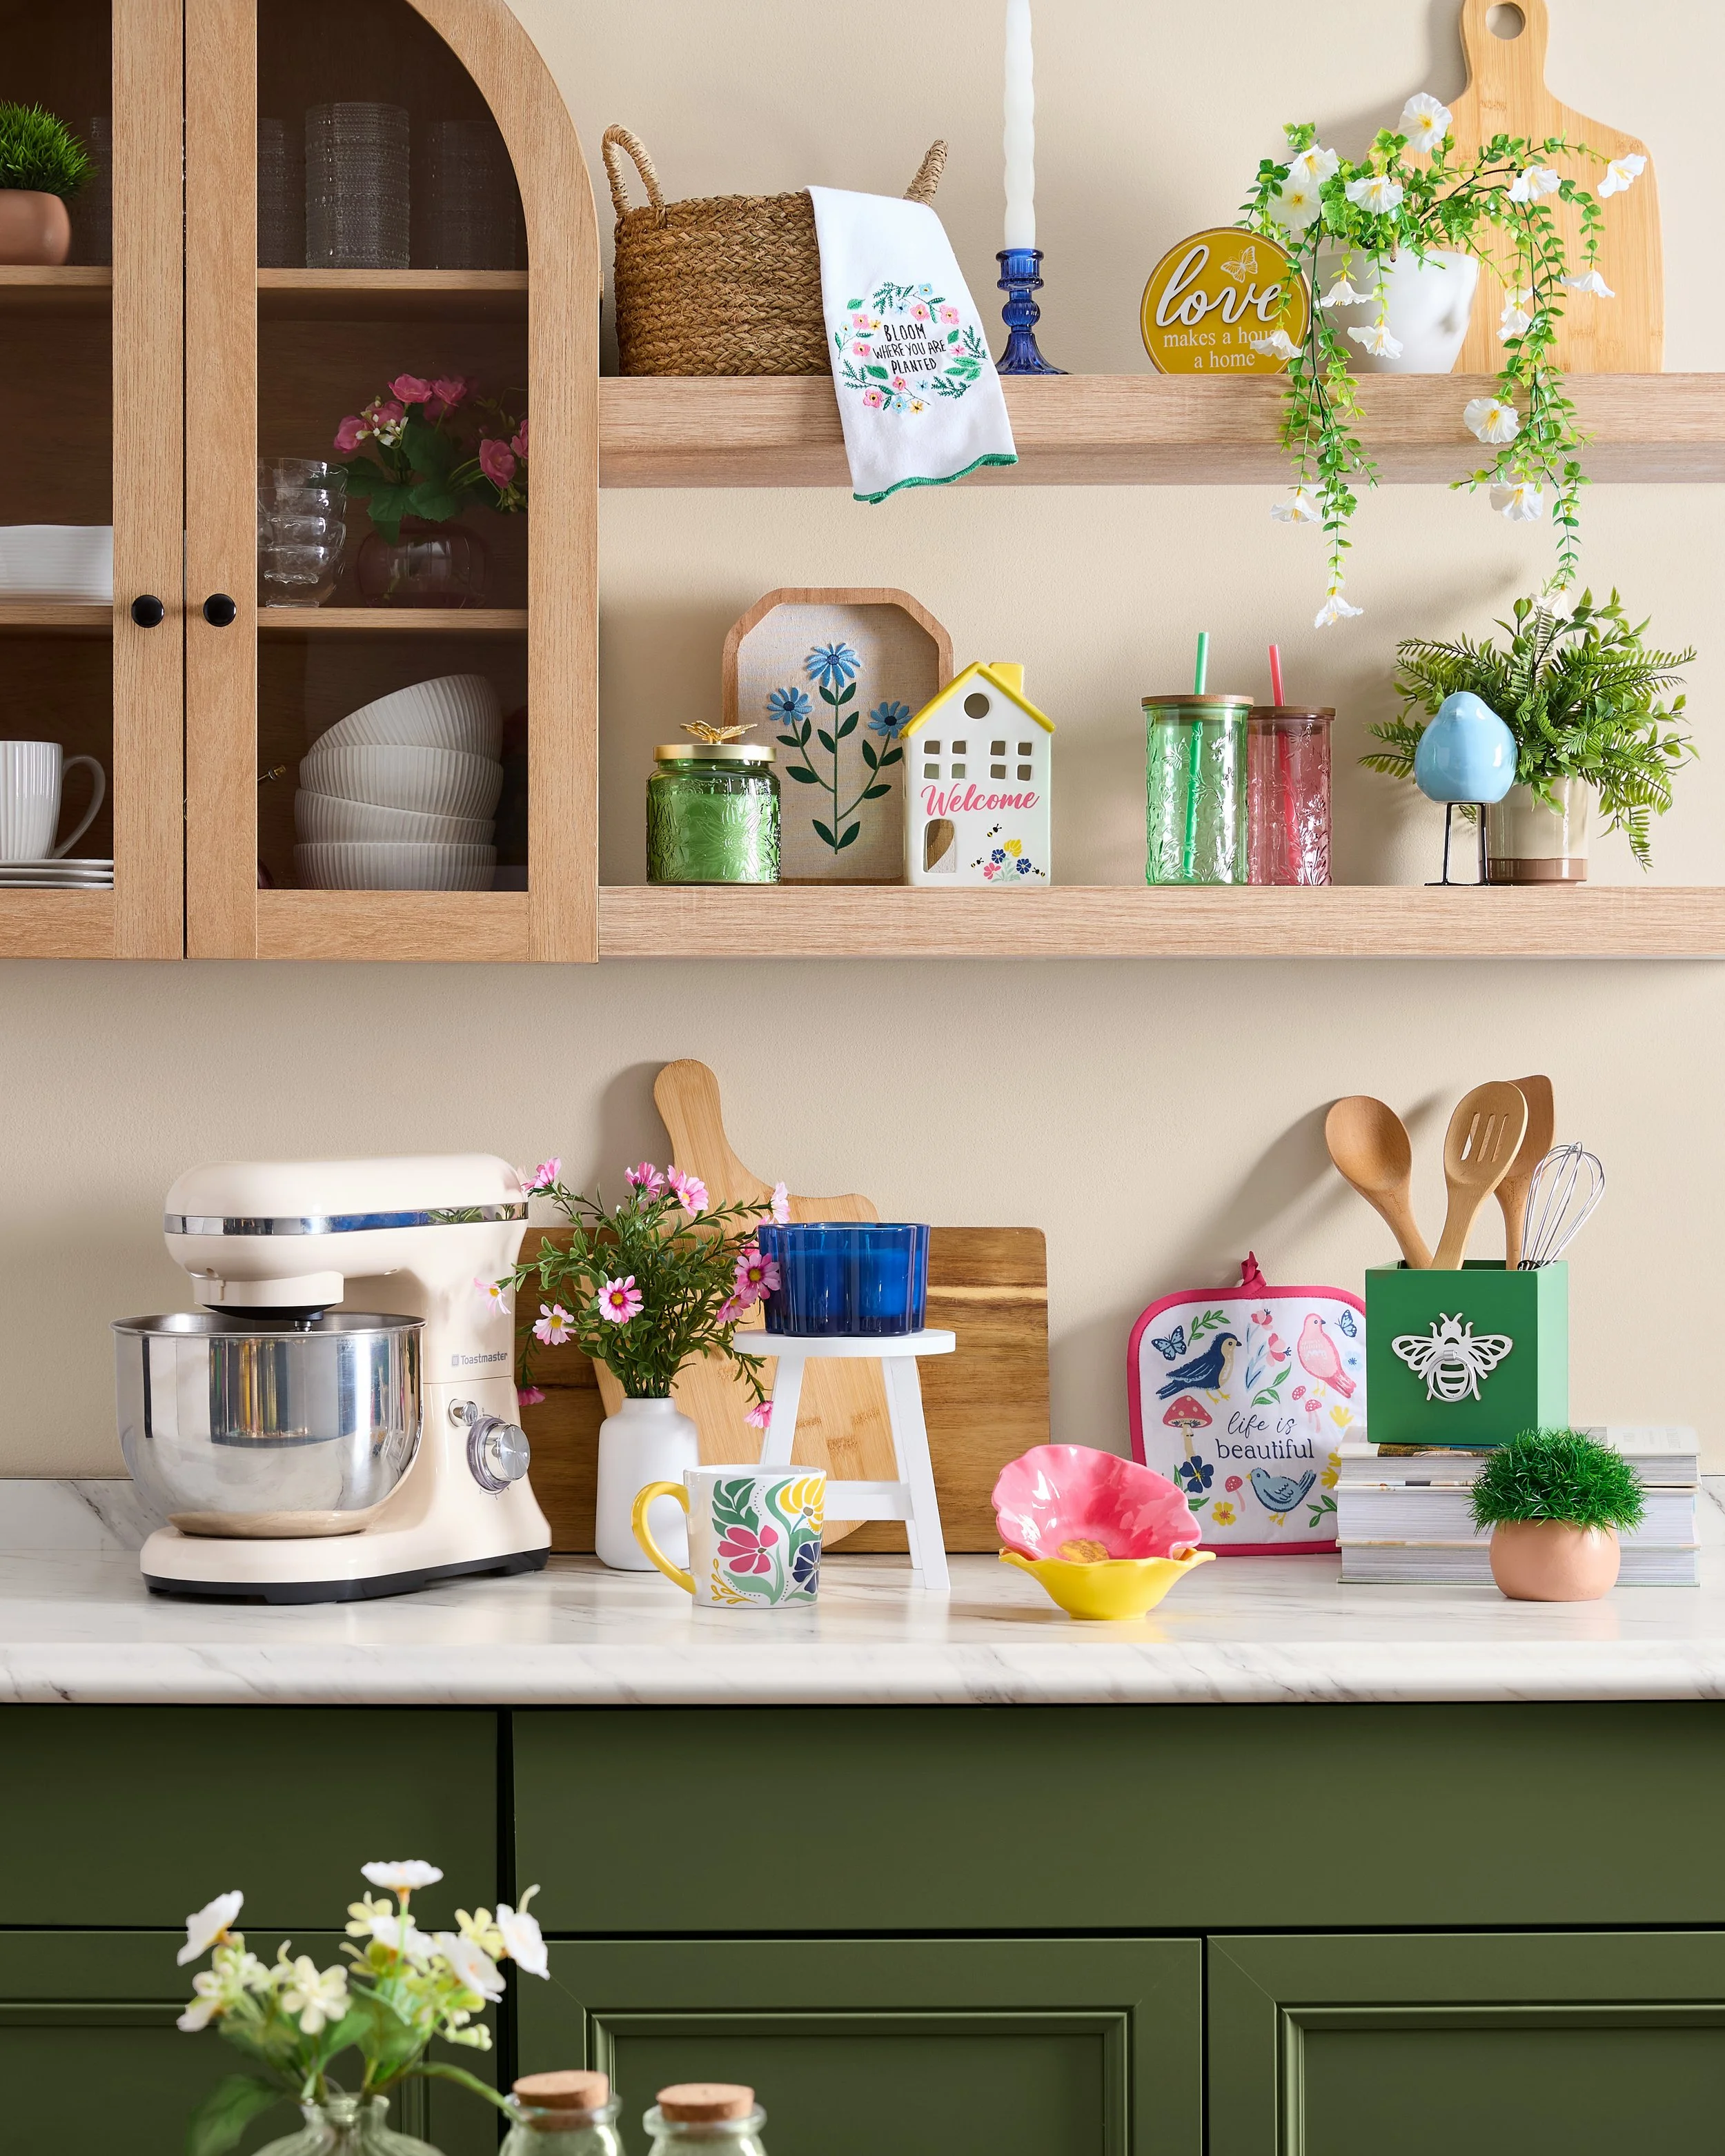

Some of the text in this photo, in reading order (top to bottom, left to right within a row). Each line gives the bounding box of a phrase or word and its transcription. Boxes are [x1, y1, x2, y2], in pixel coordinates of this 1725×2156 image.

[1156, 244, 1292, 327] love
[883, 323, 927, 342] BLOOM
[1163, 328, 1216, 348] makes
[1223, 332, 1232, 344] a
[872, 339, 947, 359] WHERE YOU ARE
[1194, 350, 1255, 368] a home
[891, 357, 937, 375] PLANTED
[920, 782, 1040, 816] Welcome
[460, 1351, 508, 1365] Toastmaster
[1227, 1411, 1298, 1439] life is
[1215, 1438, 1315, 1460] beautiful
